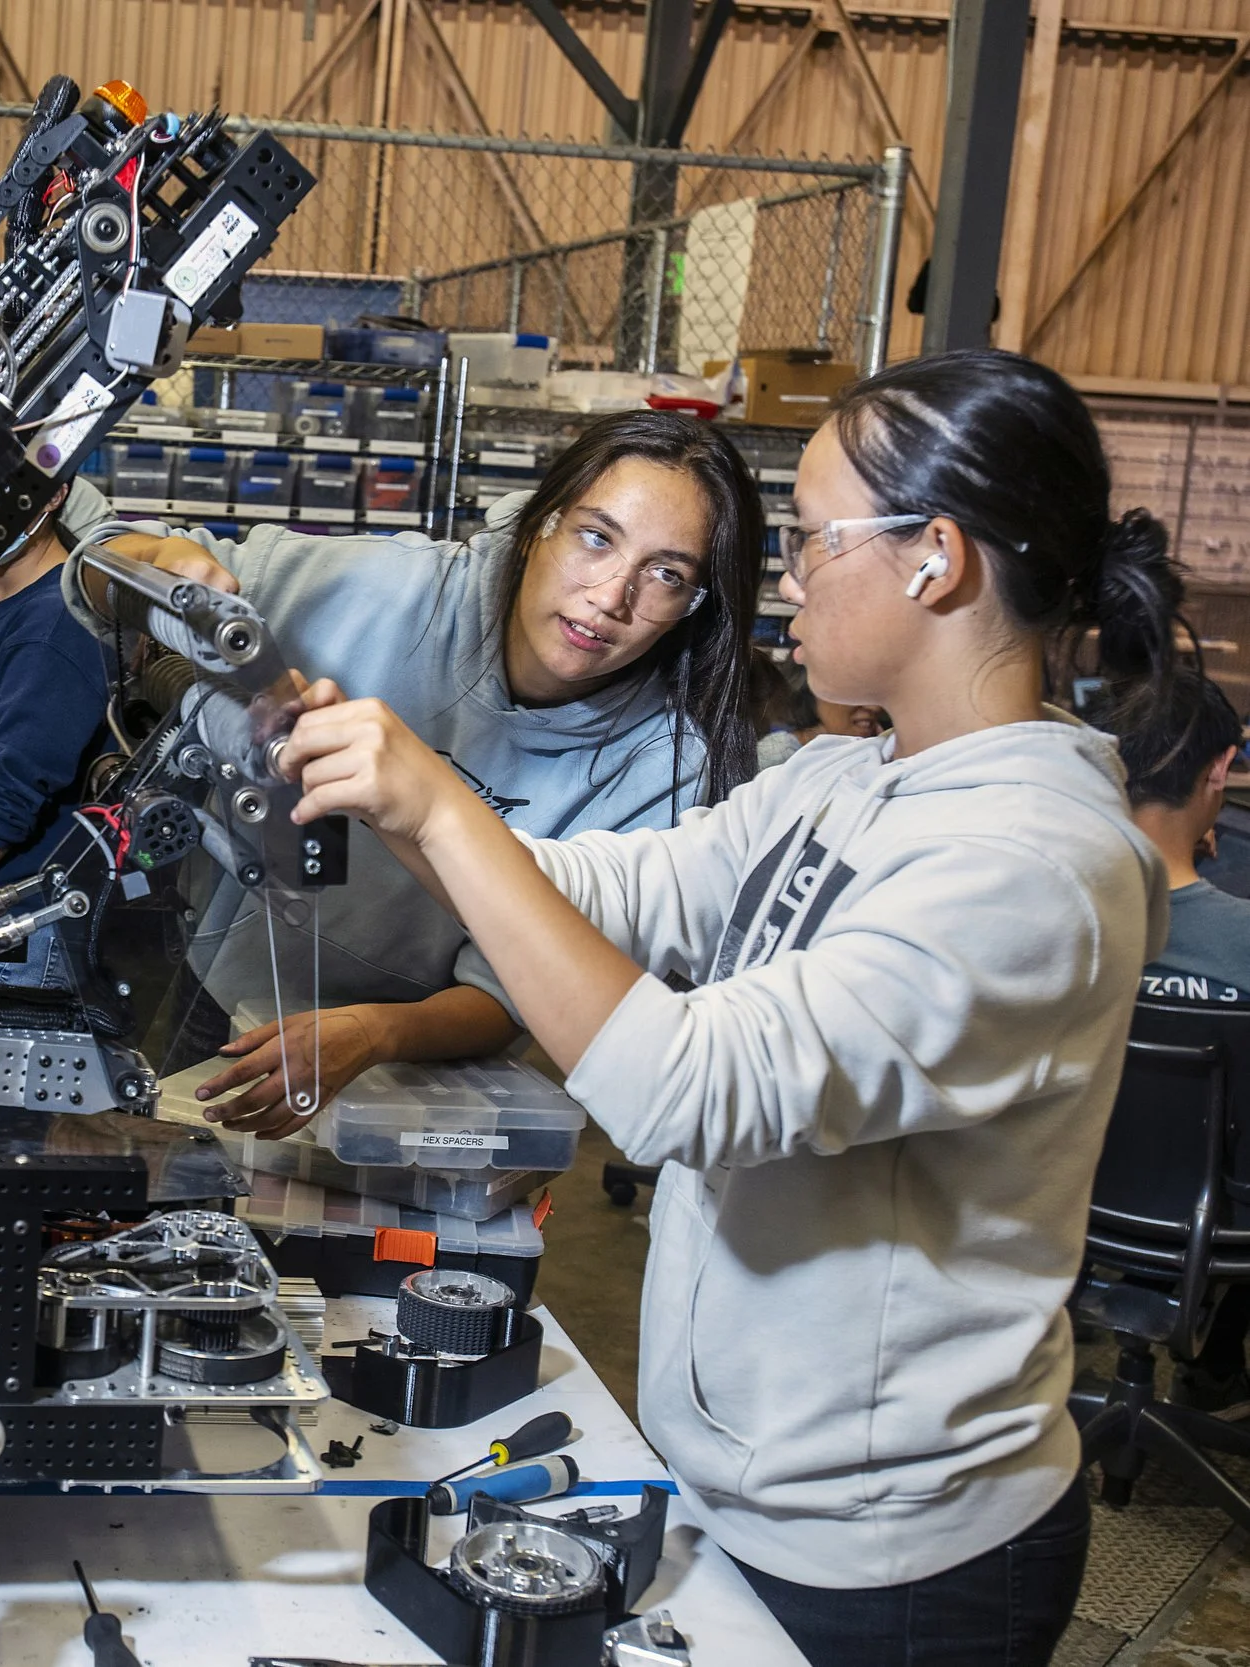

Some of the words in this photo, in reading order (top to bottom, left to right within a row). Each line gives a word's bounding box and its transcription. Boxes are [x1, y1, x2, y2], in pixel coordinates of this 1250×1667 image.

[1139, 975, 1209, 1001] NUZ
[422, 1136, 440, 1145] HEX
[442, 1137, 484, 1147] SPACERS
